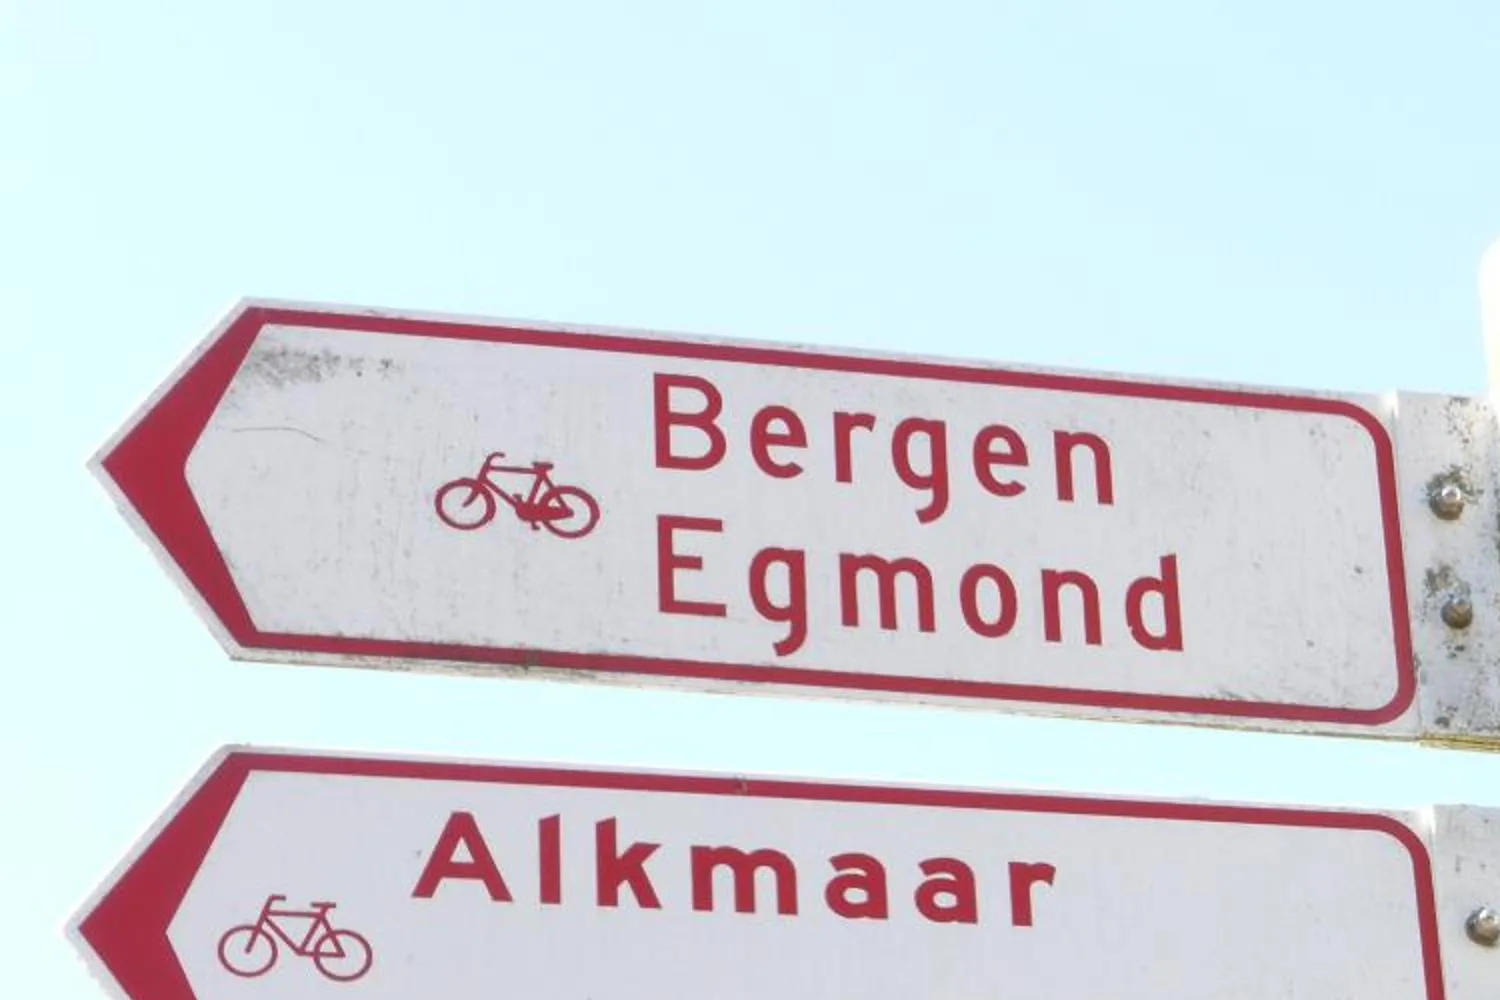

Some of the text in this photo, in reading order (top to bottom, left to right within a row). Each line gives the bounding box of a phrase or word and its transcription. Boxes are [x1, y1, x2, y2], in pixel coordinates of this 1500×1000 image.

[652, 372, 1115, 526] Bergen
[656, 513, 1185, 658] Egmond
[414, 810, 1057, 930] Alkmaar
